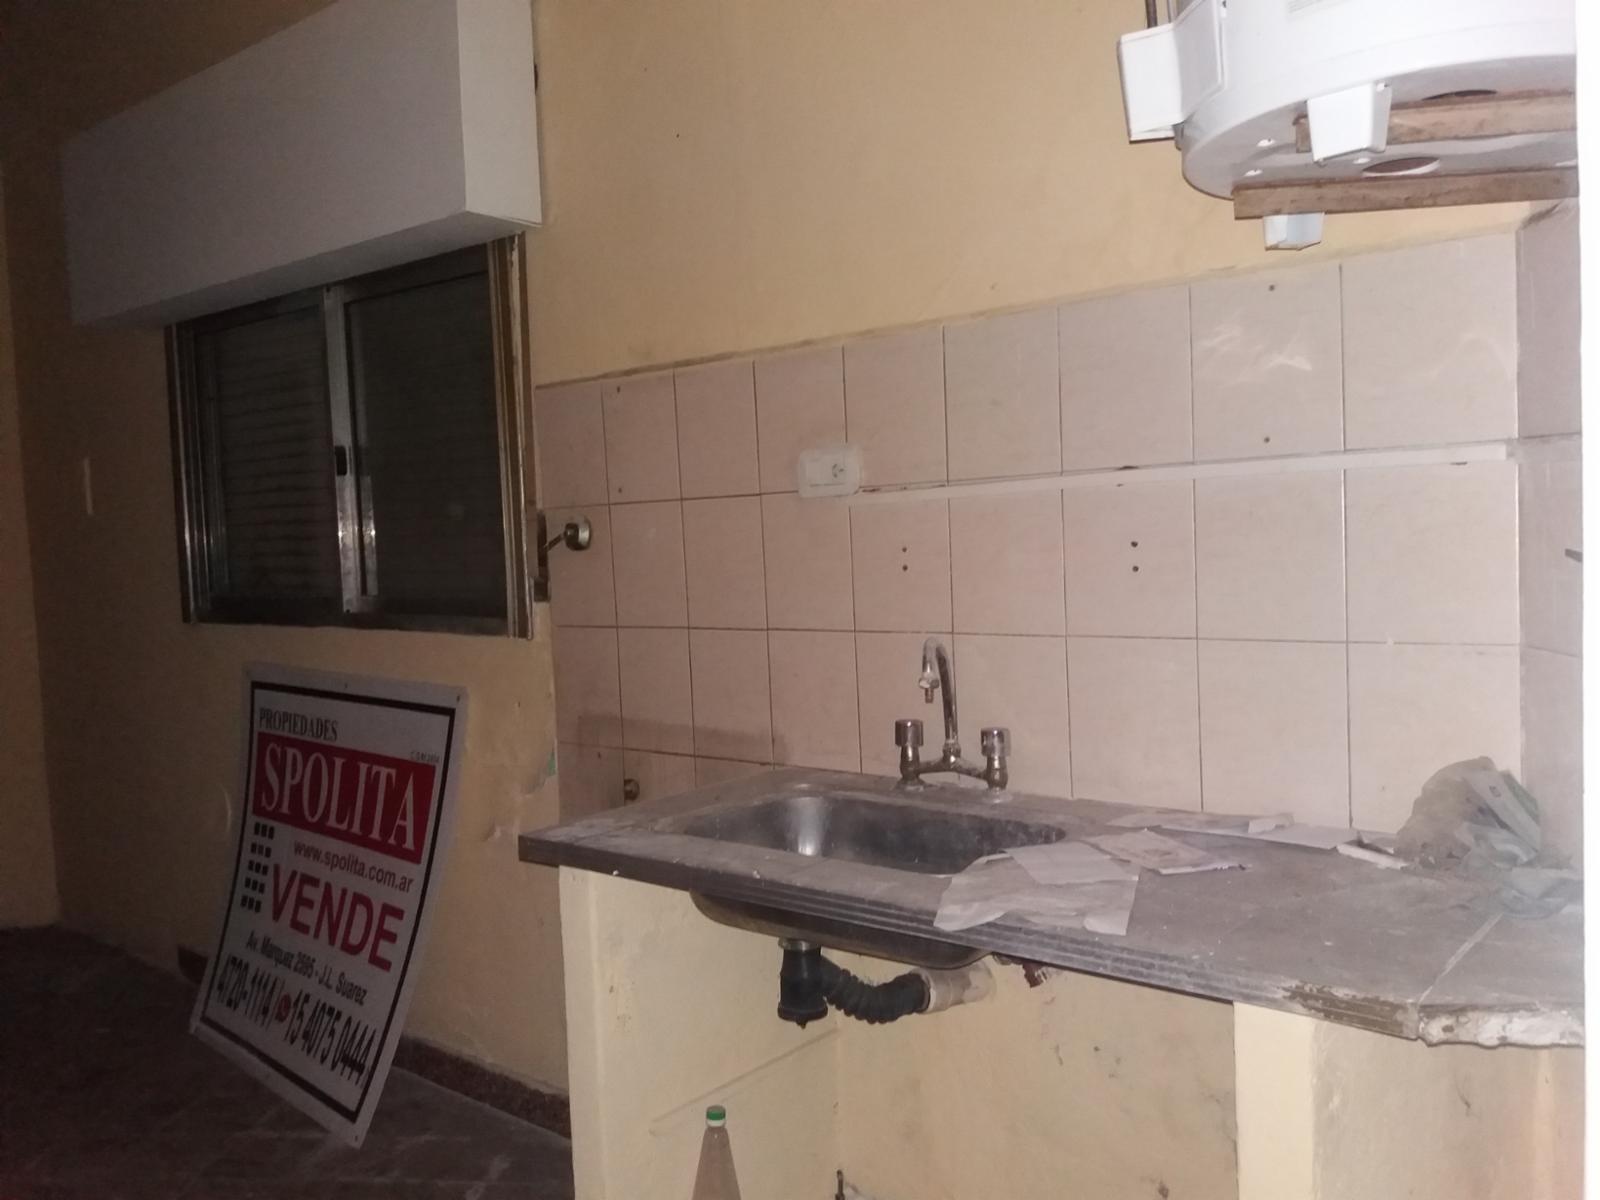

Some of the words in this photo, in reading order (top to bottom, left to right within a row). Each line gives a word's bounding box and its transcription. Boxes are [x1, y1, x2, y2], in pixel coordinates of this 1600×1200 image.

[259, 707, 338, 742] PROPIEDADES
[261, 743, 416, 851] SPOLITA
[293, 841, 414, 893] www.spolita.com.ar
[271, 864, 405, 973] VENDE
[335, 971, 367, 1006] Suarez
[284, 989, 311, 1046] 15
[301, 999, 342, 1065] 4075
